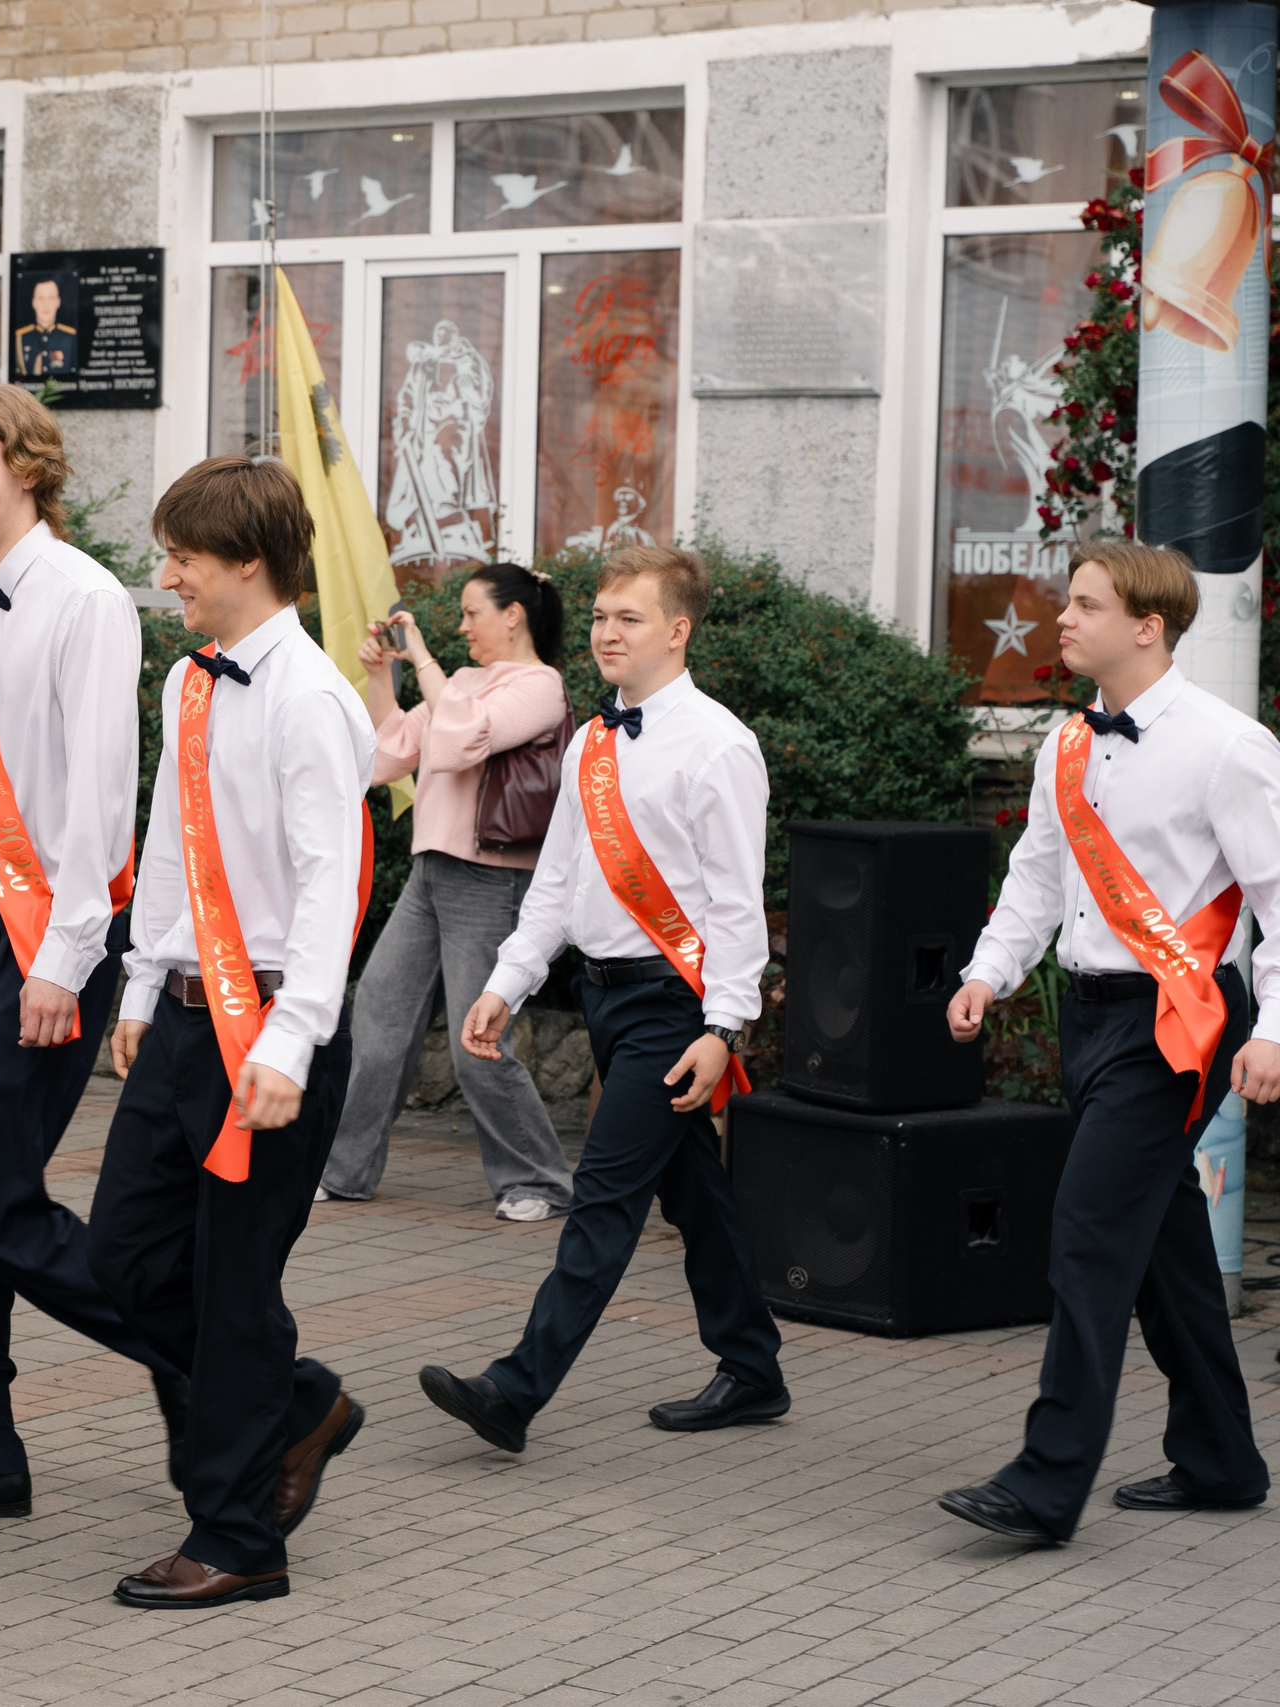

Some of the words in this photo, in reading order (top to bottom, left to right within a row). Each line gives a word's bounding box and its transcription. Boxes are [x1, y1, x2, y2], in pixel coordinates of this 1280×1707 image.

[954, 542, 1070, 580] ПОБЕДА
[589, 757, 651, 902] Выпускник
[1062, 757, 1130, 909] Выпускник
[212, 935, 260, 1016] 2026
[1126, 908, 1200, 977] 2026
